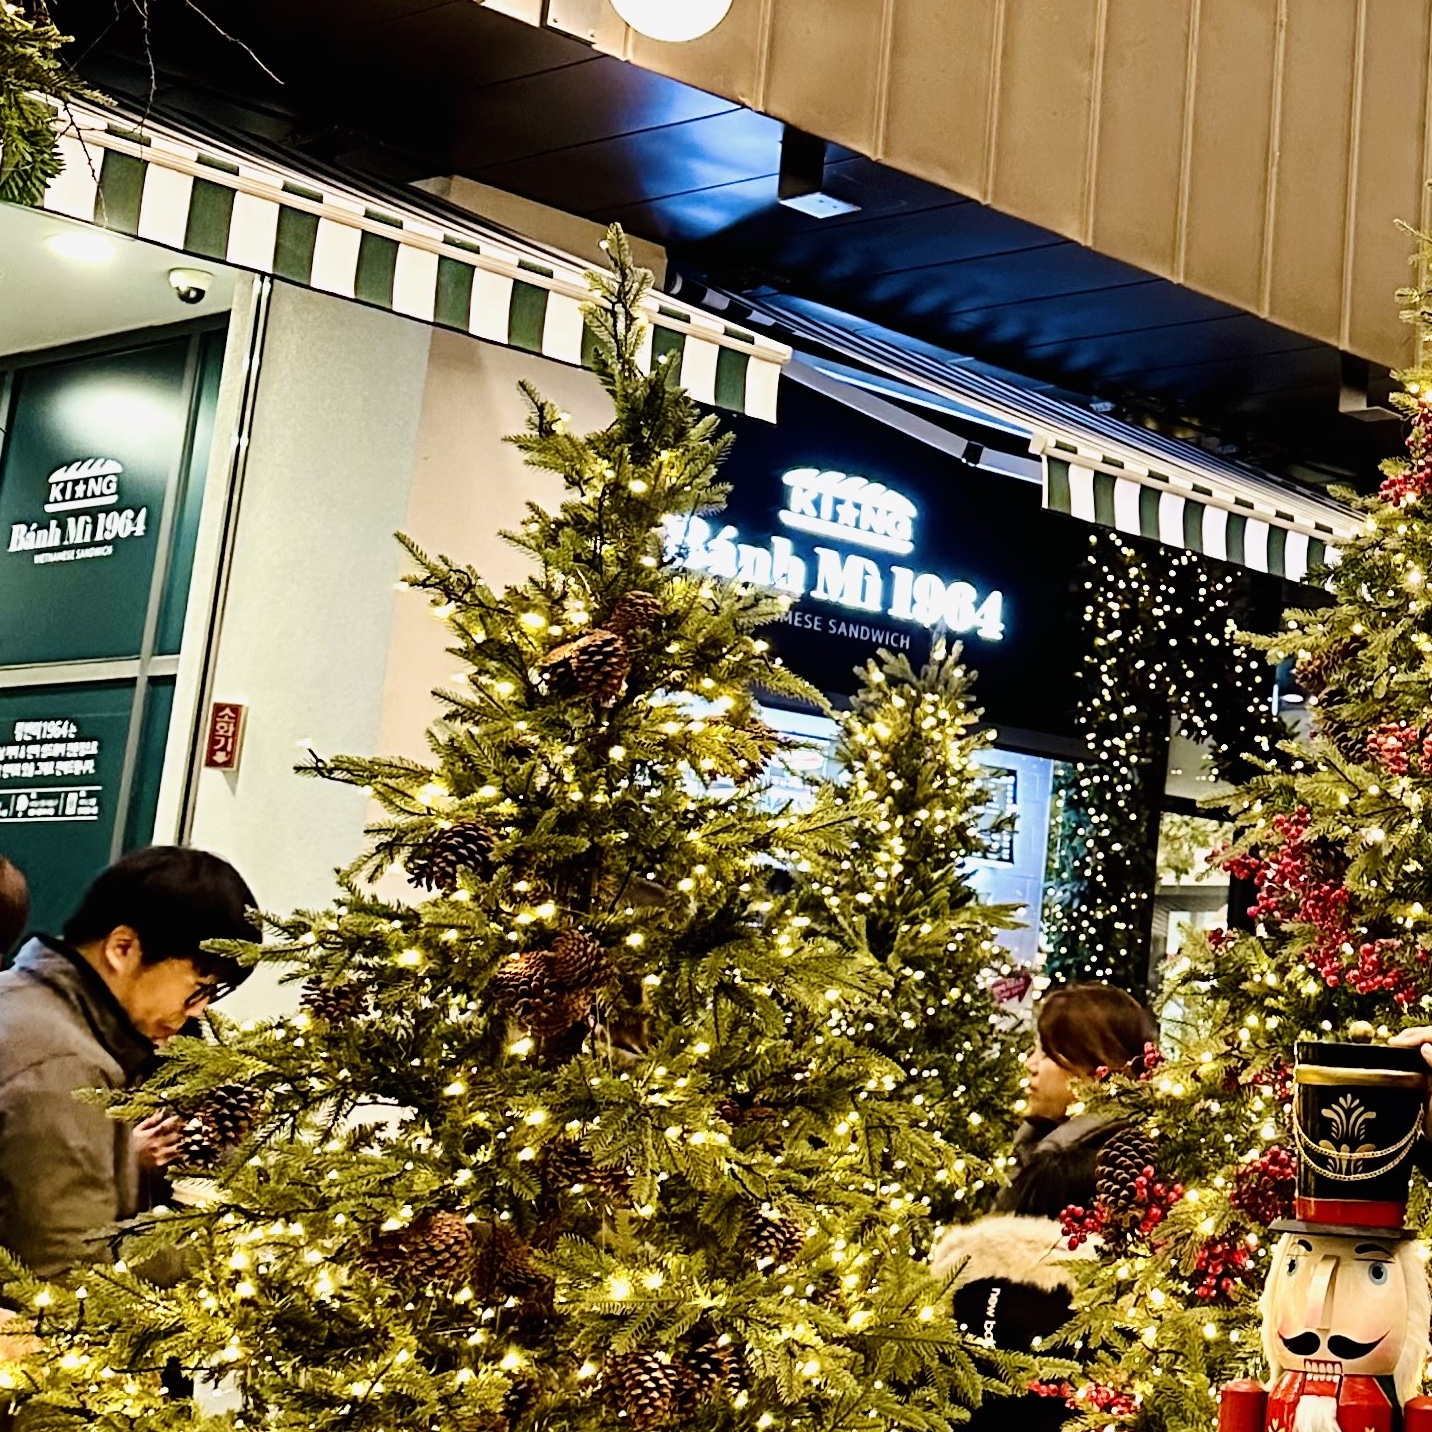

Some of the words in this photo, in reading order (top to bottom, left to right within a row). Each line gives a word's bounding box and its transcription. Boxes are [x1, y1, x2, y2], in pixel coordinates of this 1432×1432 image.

[94, 507, 147, 541] 1964
[888, 564, 1006, 642] 1964
[828, 619, 911, 650] SANDWICH
[213, 707, 236, 753] 소화기
